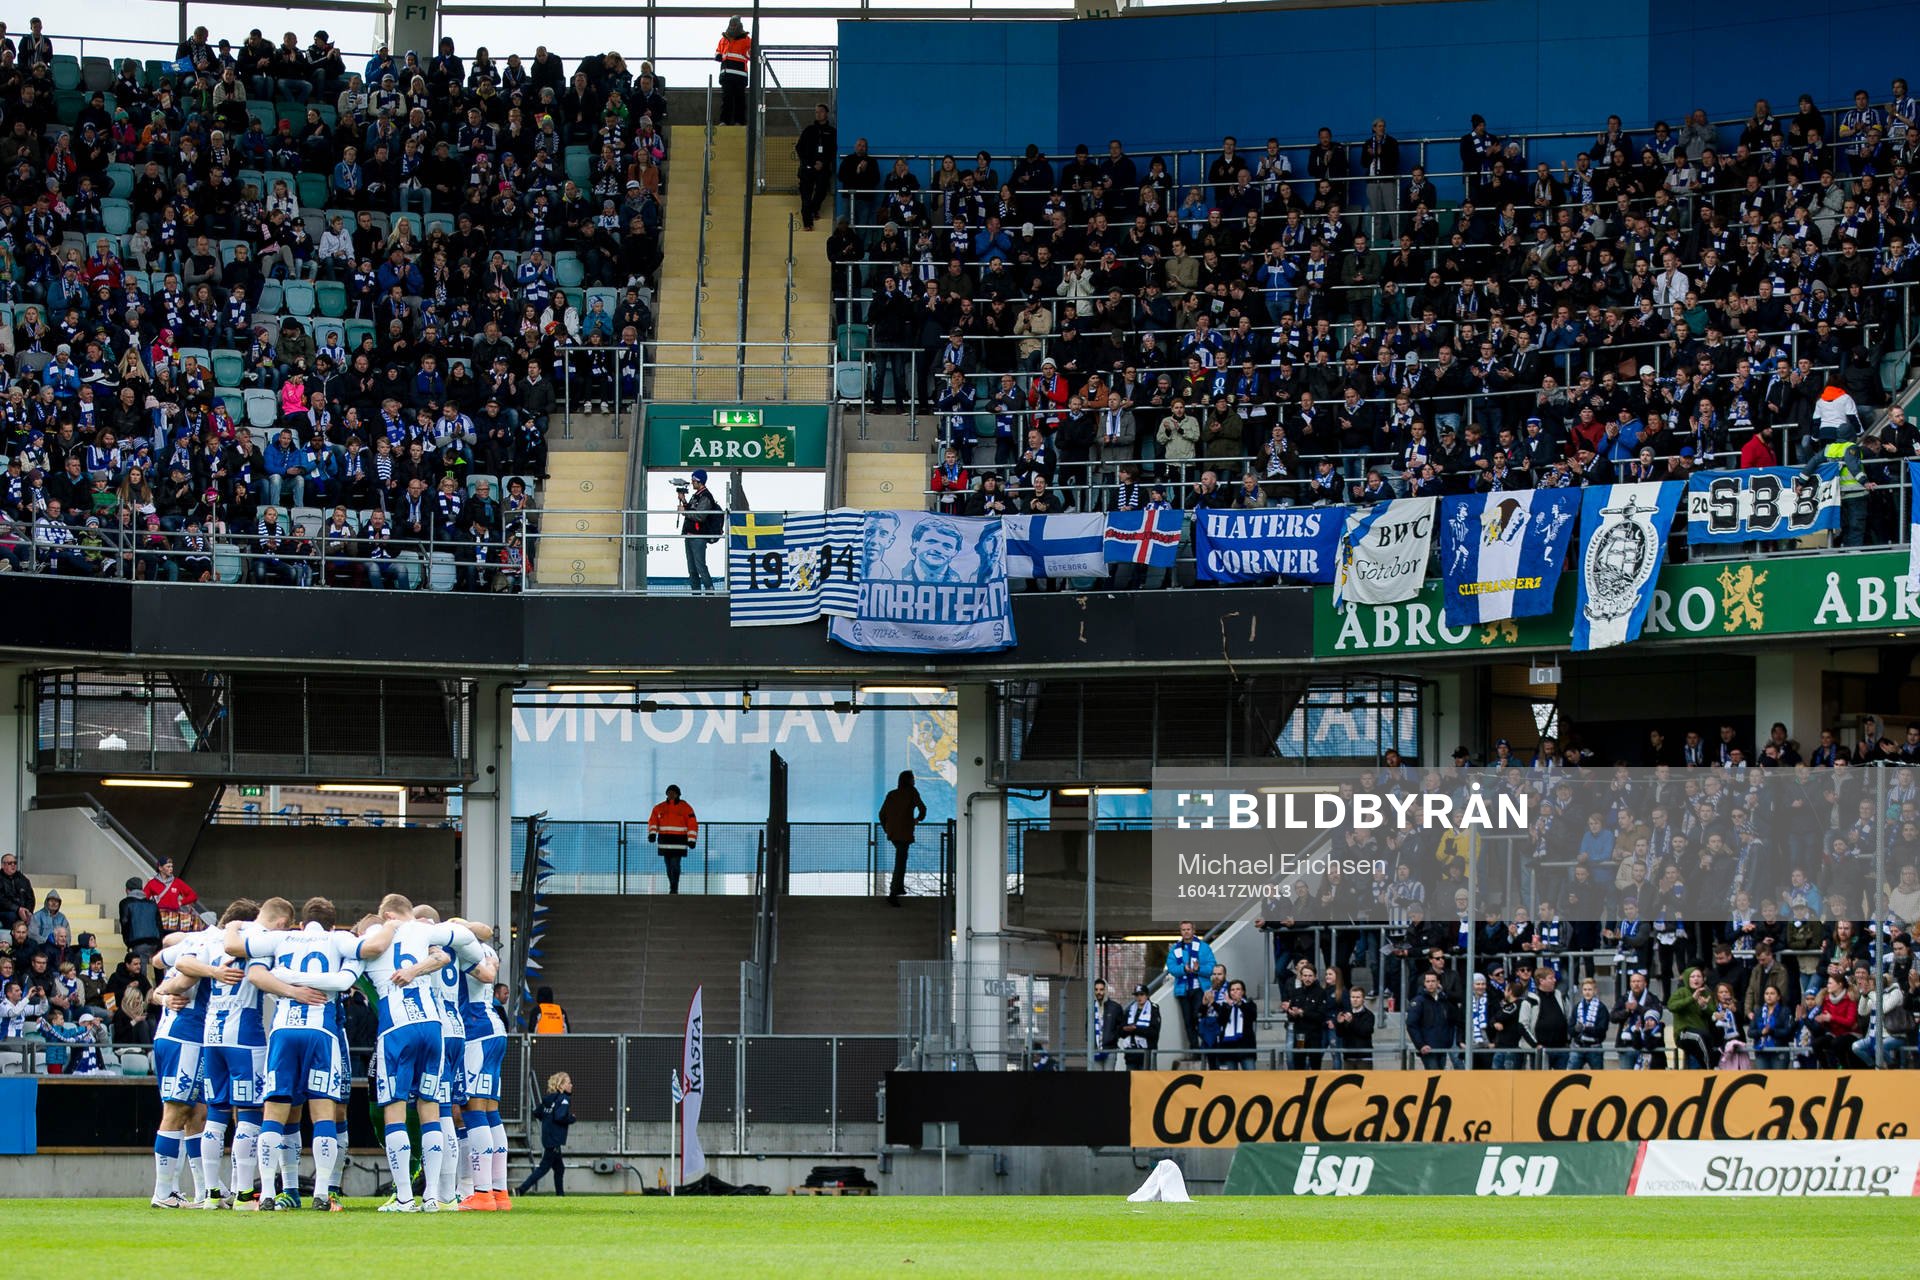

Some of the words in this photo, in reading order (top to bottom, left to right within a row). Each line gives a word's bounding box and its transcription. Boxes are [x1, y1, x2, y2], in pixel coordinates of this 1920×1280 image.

[405, 5, 427, 21] F1
[688, 437, 762, 459] ÅBRO
[1692, 497, 1709, 514] 20
[1707, 473, 1822, 535] SBB
[1206, 513, 1322, 539] HATERS
[1376, 514, 1432, 548] BWC
[747, 551, 783, 590] 19
[1207, 549, 1320, 575] CORNER
[1536, 668, 1553, 683] G1
[689, 1015, 703, 1095] KASTA
[1151, 1073, 1493, 1145] GoodCash.se
[1293, 1145, 1375, 1197] isp
[1475, 1145, 1560, 1197] isp
[1701, 1155, 1900, 1197] Shopping
